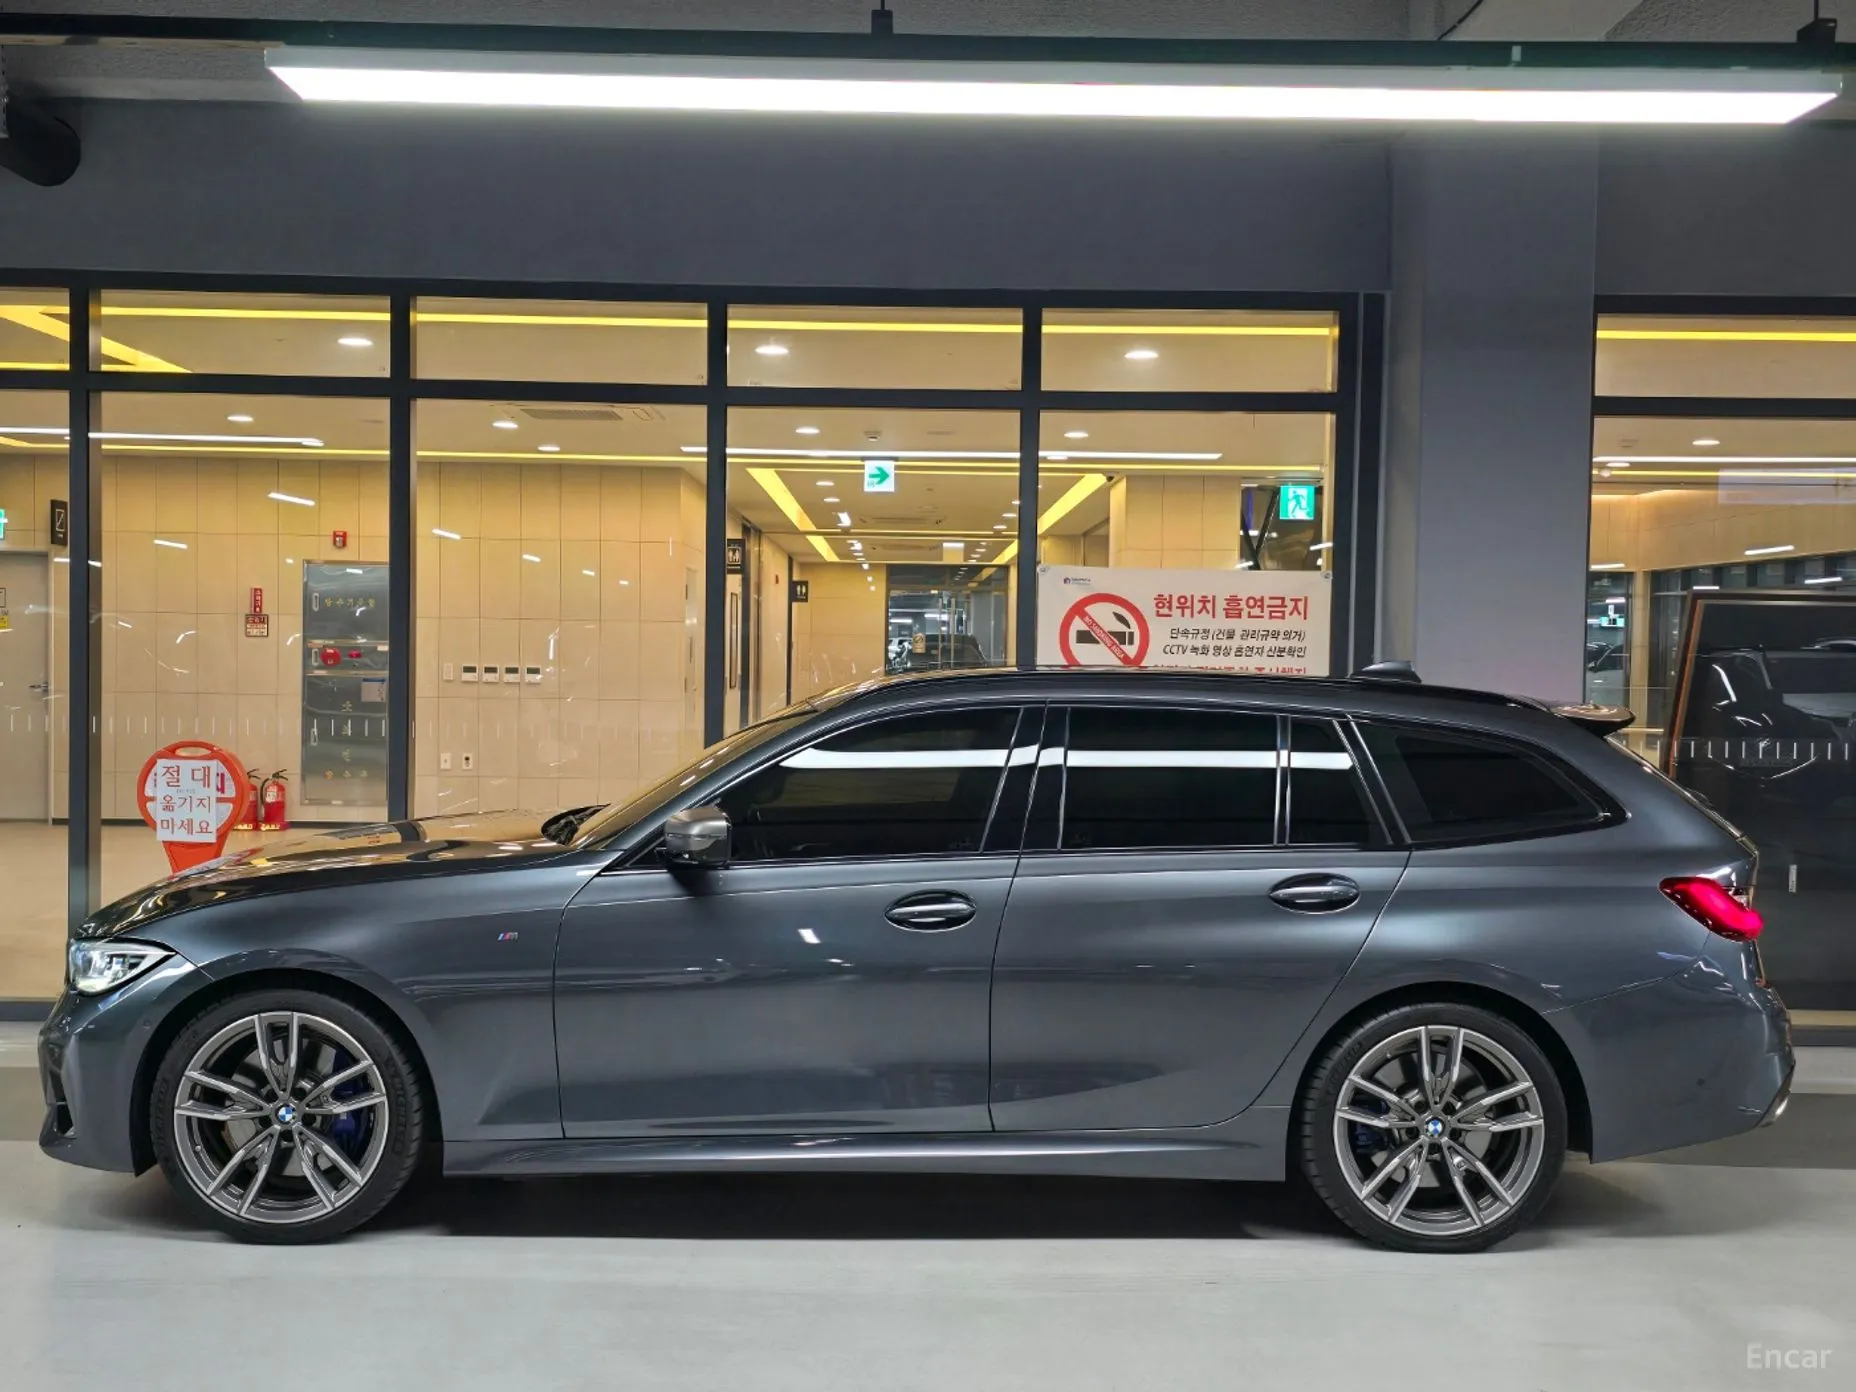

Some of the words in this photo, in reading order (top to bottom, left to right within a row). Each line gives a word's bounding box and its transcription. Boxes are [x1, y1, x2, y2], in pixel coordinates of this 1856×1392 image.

[1154, 594, 1216, 619] 현위치
[1223, 595, 1308, 620] 흡연금지
[1240, 629, 1280, 642] 관리규약
[1283, 630, 1306, 642] 의거)
[1163, 644, 1188, 655] CCTV
[1190, 644, 1209, 657] 녹화
[1212, 645, 1231, 657] 영상
[1234, 645, 1264, 658] 흡연자
[1266, 646, 1307, 658] 신분확인
[160, 794, 211, 813] 옮기지
[160, 817, 213, 835] 마세요
